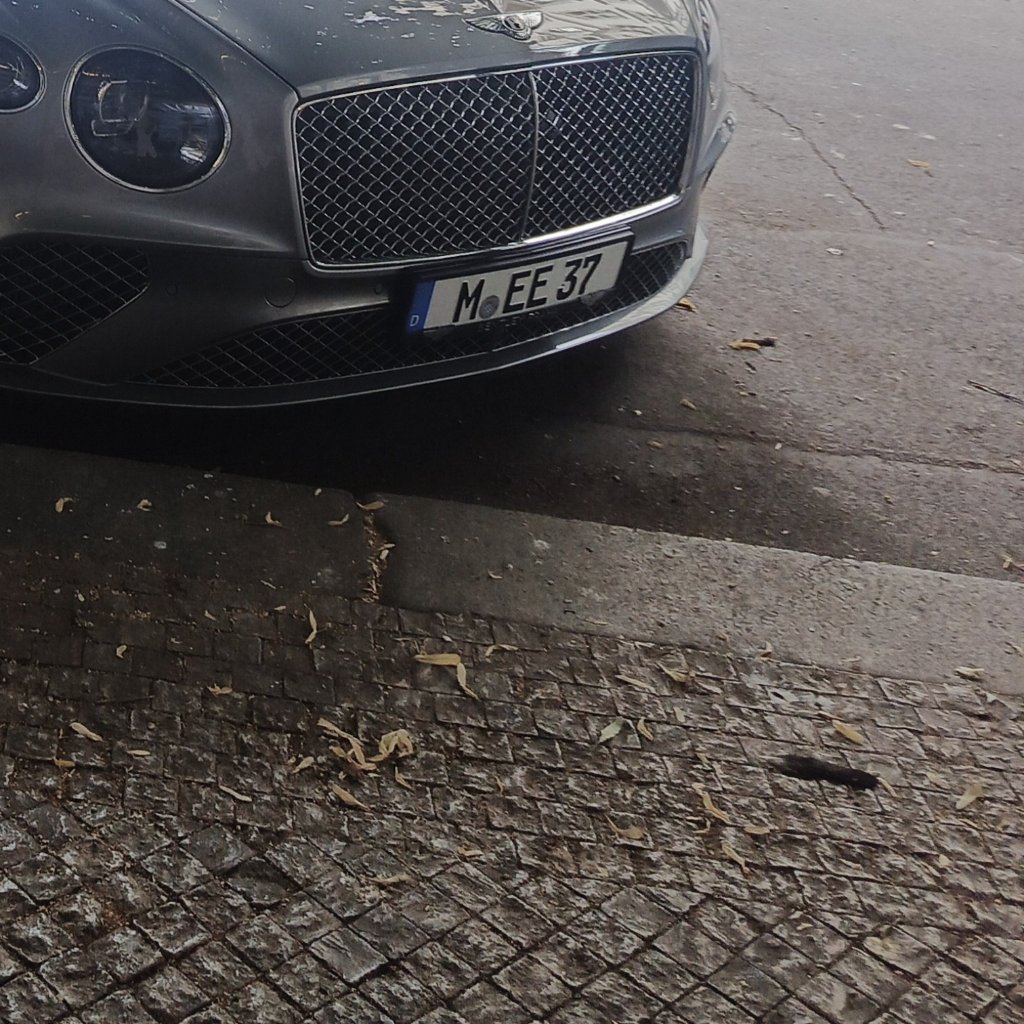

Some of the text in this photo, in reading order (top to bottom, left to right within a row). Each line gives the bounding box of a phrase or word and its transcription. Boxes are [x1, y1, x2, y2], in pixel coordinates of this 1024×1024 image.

[451, 279, 485, 323] M
[502, 265, 553, 314] EE
[556, 252, 603, 301] 37
[410, 314, 420, 327] D
